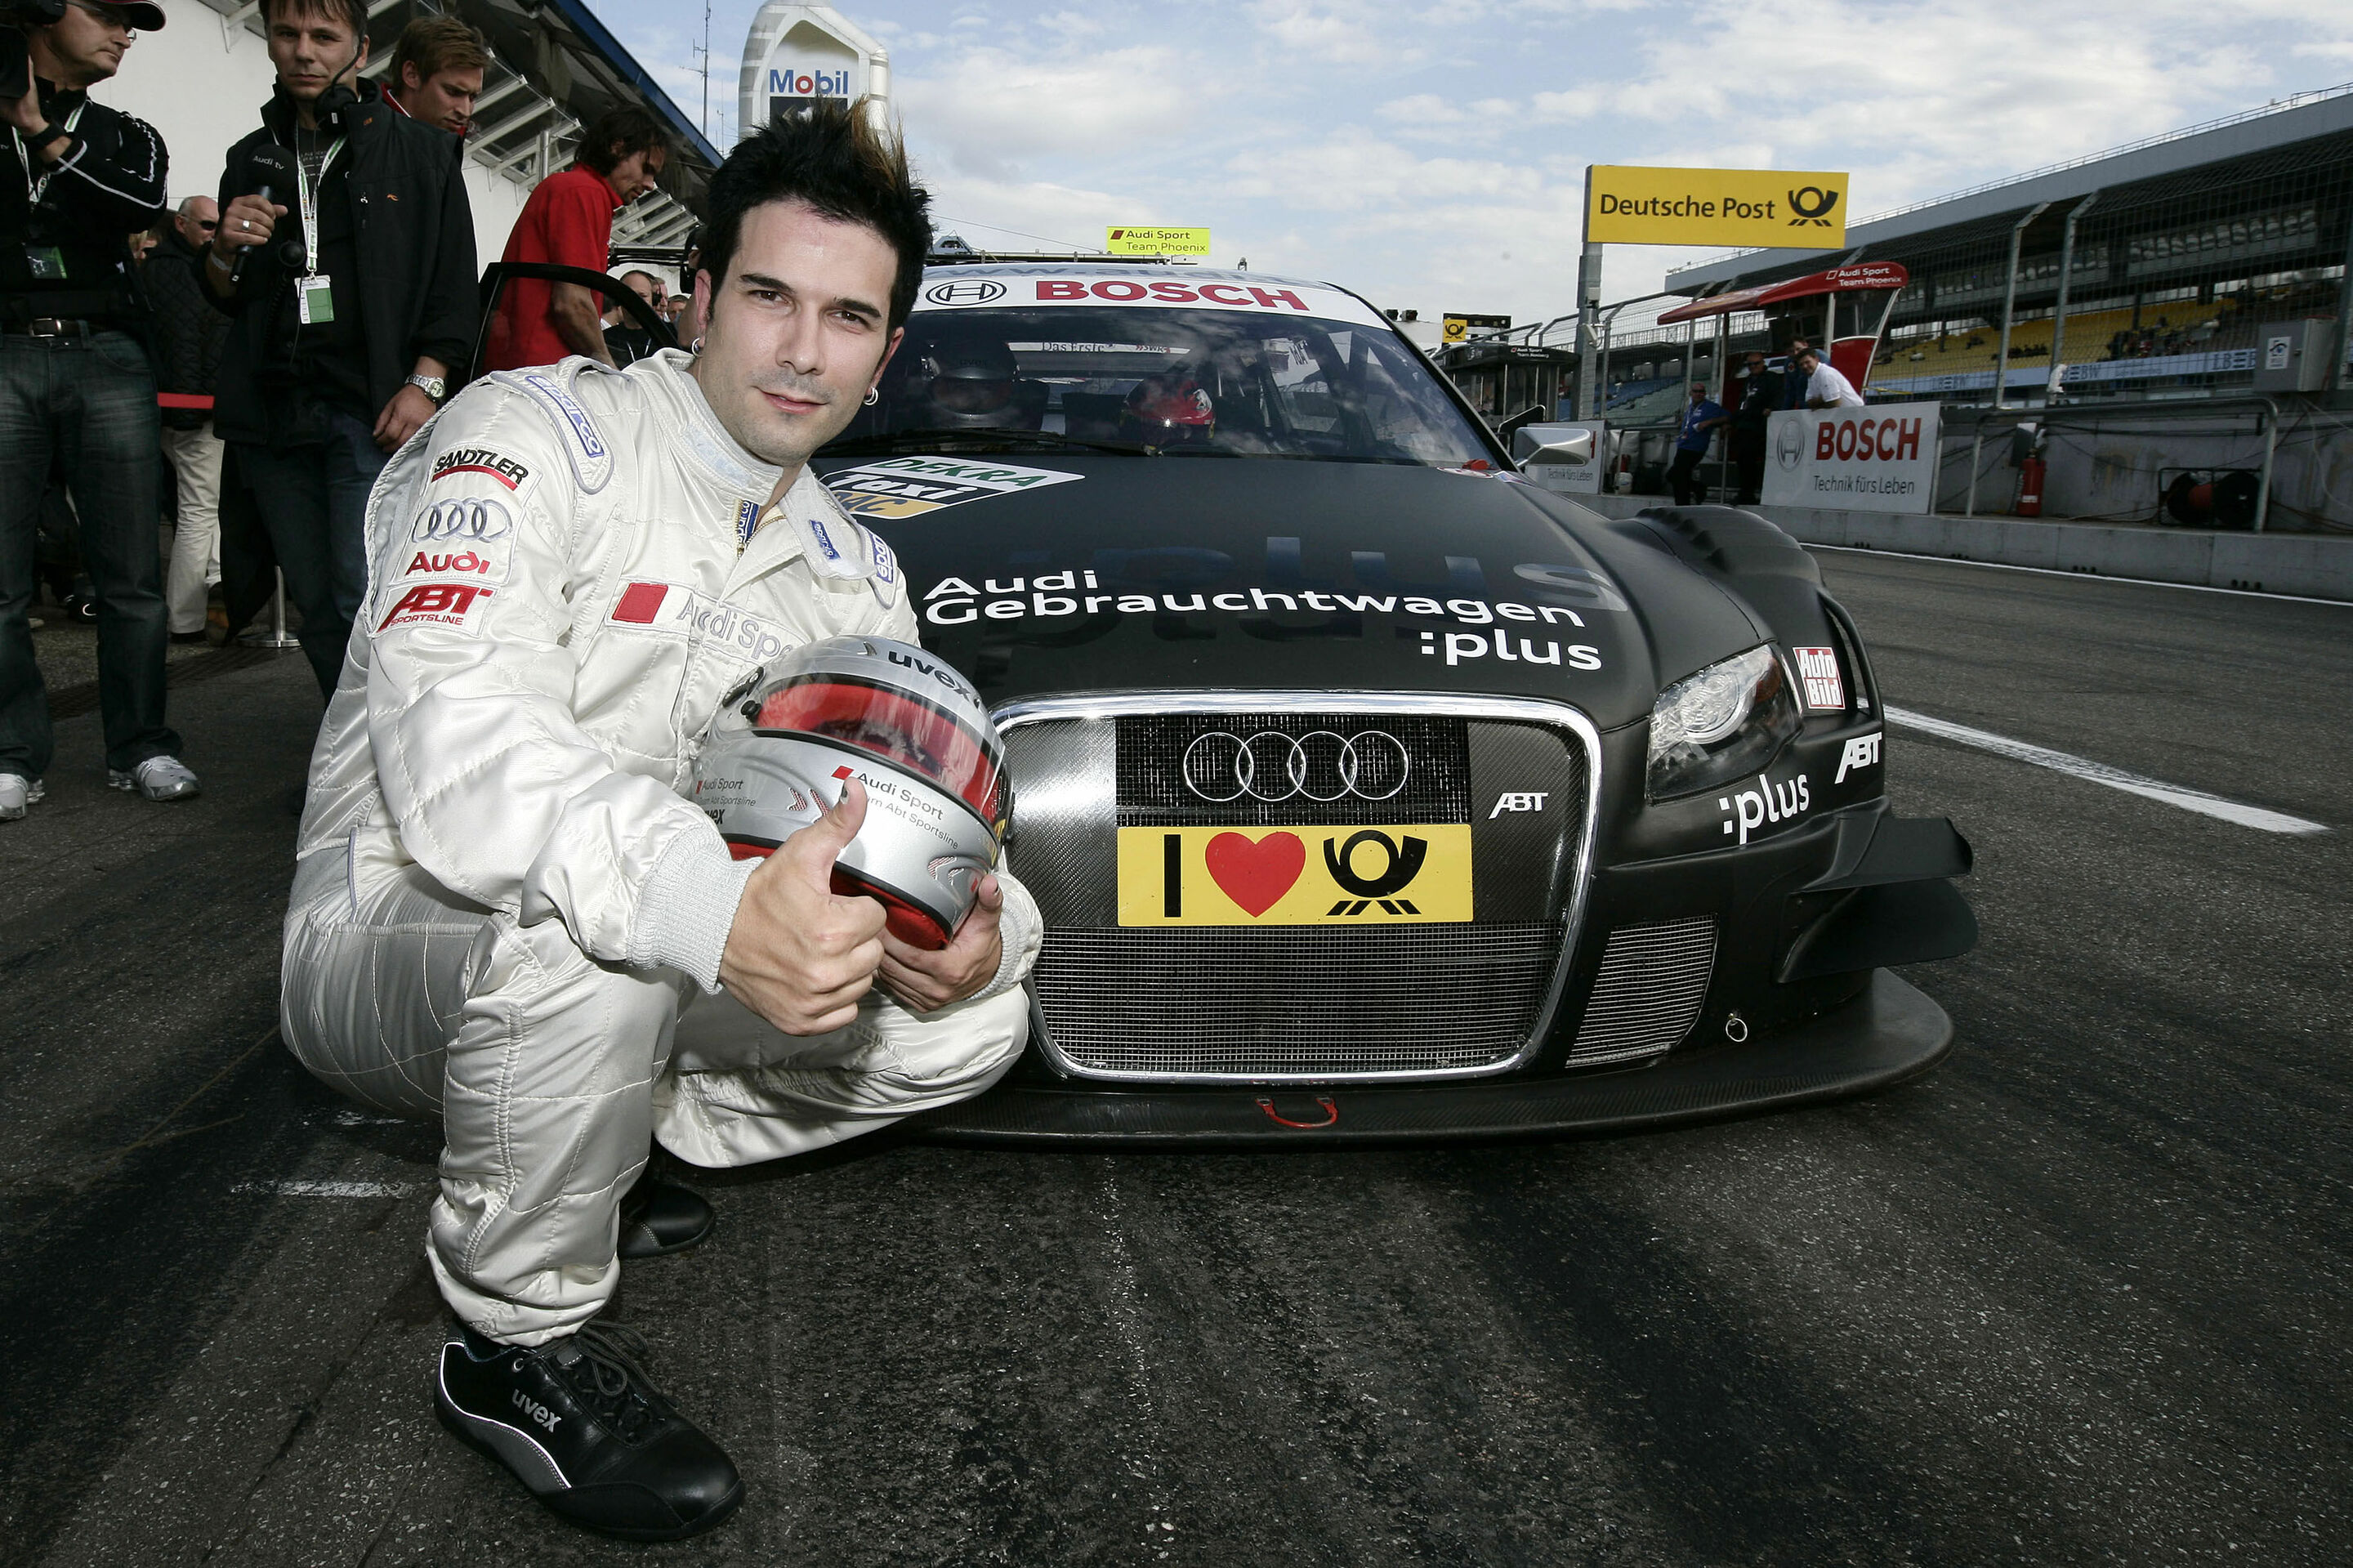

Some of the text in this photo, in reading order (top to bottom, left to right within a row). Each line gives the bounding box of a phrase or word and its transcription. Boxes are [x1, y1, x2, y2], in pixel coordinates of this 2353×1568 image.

[770, 69, 848, 94] Mobil
[253, 154, 284, 170] Audi tv
[1600, 194, 1775, 219] Deutsche Post
[1126, 230, 1190, 240] Audi Sport
[1127, 242, 1206, 252] Team Phoenix
[1838, 276, 1902, 287] Team Phoenix
[1863, 267, 1890, 276] Sport
[1036, 280, 1310, 311] BOSCH
[1815, 418, 1922, 461] BOSCH
[435, 449, 529, 485] SANDTLER
[870, 458, 1048, 487] DEKRA
[830, 473, 978, 500] Taxi
[1814, 476, 1915, 494] Technik fürs Leben
[405, 551, 490, 575] Audi
[923, 570, 1098, 600] Audi
[377, 583, 493, 633] ABT
[390, 614, 463, 627] SPORTSLINE
[925, 587, 1586, 627] Gebrauchtwagen
[1420, 628, 1603, 672] :plus
[1799, 649, 1837, 678] Auto
[888, 651, 971, 702] uvex
[1806, 678, 1842, 705] Bild
[1835, 732, 1882, 784] ABT
[702, 778, 743, 792] Audi Sport
[858, 773, 944, 820] Audi Sport
[721, 796, 757, 806] Sportsline
[1488, 792, 1548, 820] ABT
[1720, 773, 1809, 845] :plus
[885, 802, 958, 850] Abt Sportsline
[1164, 834, 1181, 917] I
[511, 1389, 562, 1432] uvex
